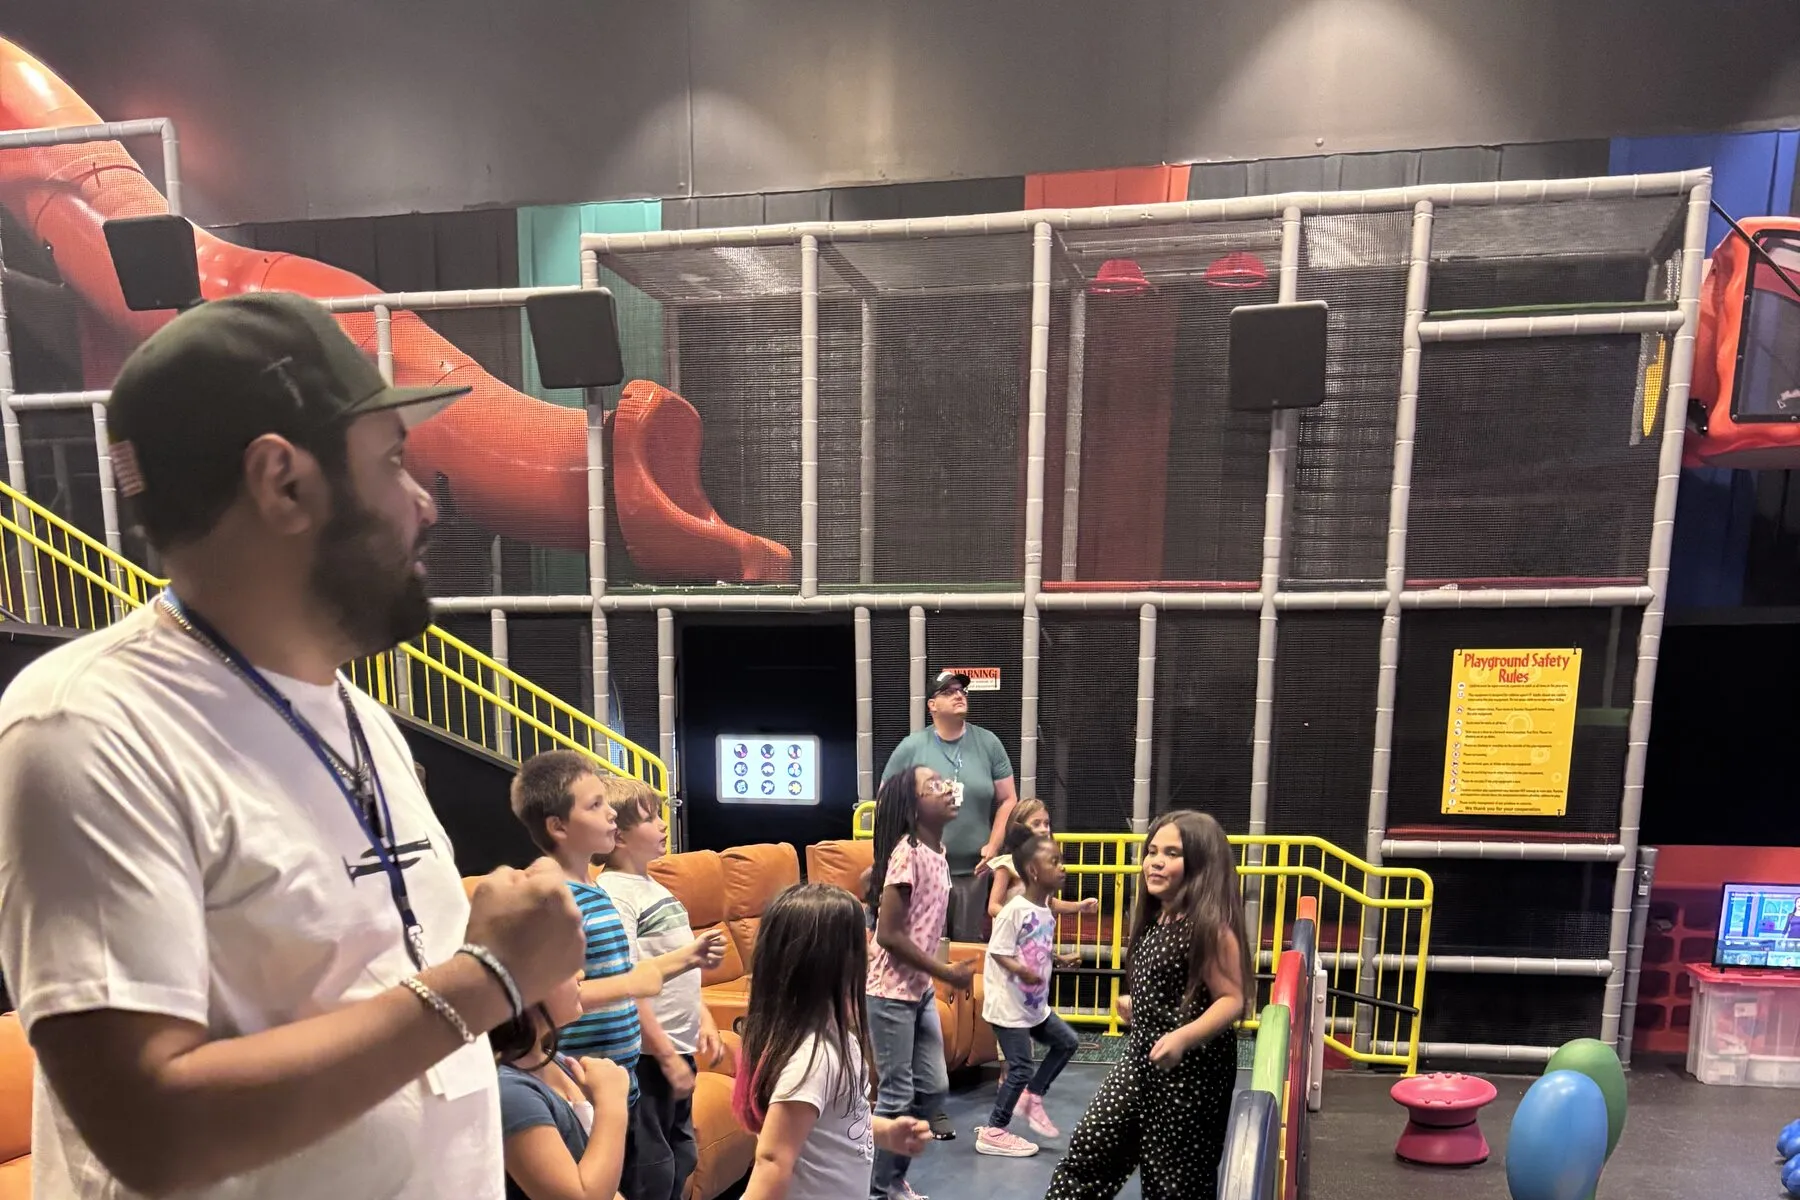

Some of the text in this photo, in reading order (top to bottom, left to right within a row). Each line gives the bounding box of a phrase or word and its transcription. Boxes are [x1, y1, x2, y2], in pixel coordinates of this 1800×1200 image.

[1463, 653, 1570, 671] Playground Safety
[1498, 668, 1529, 683] Rules
